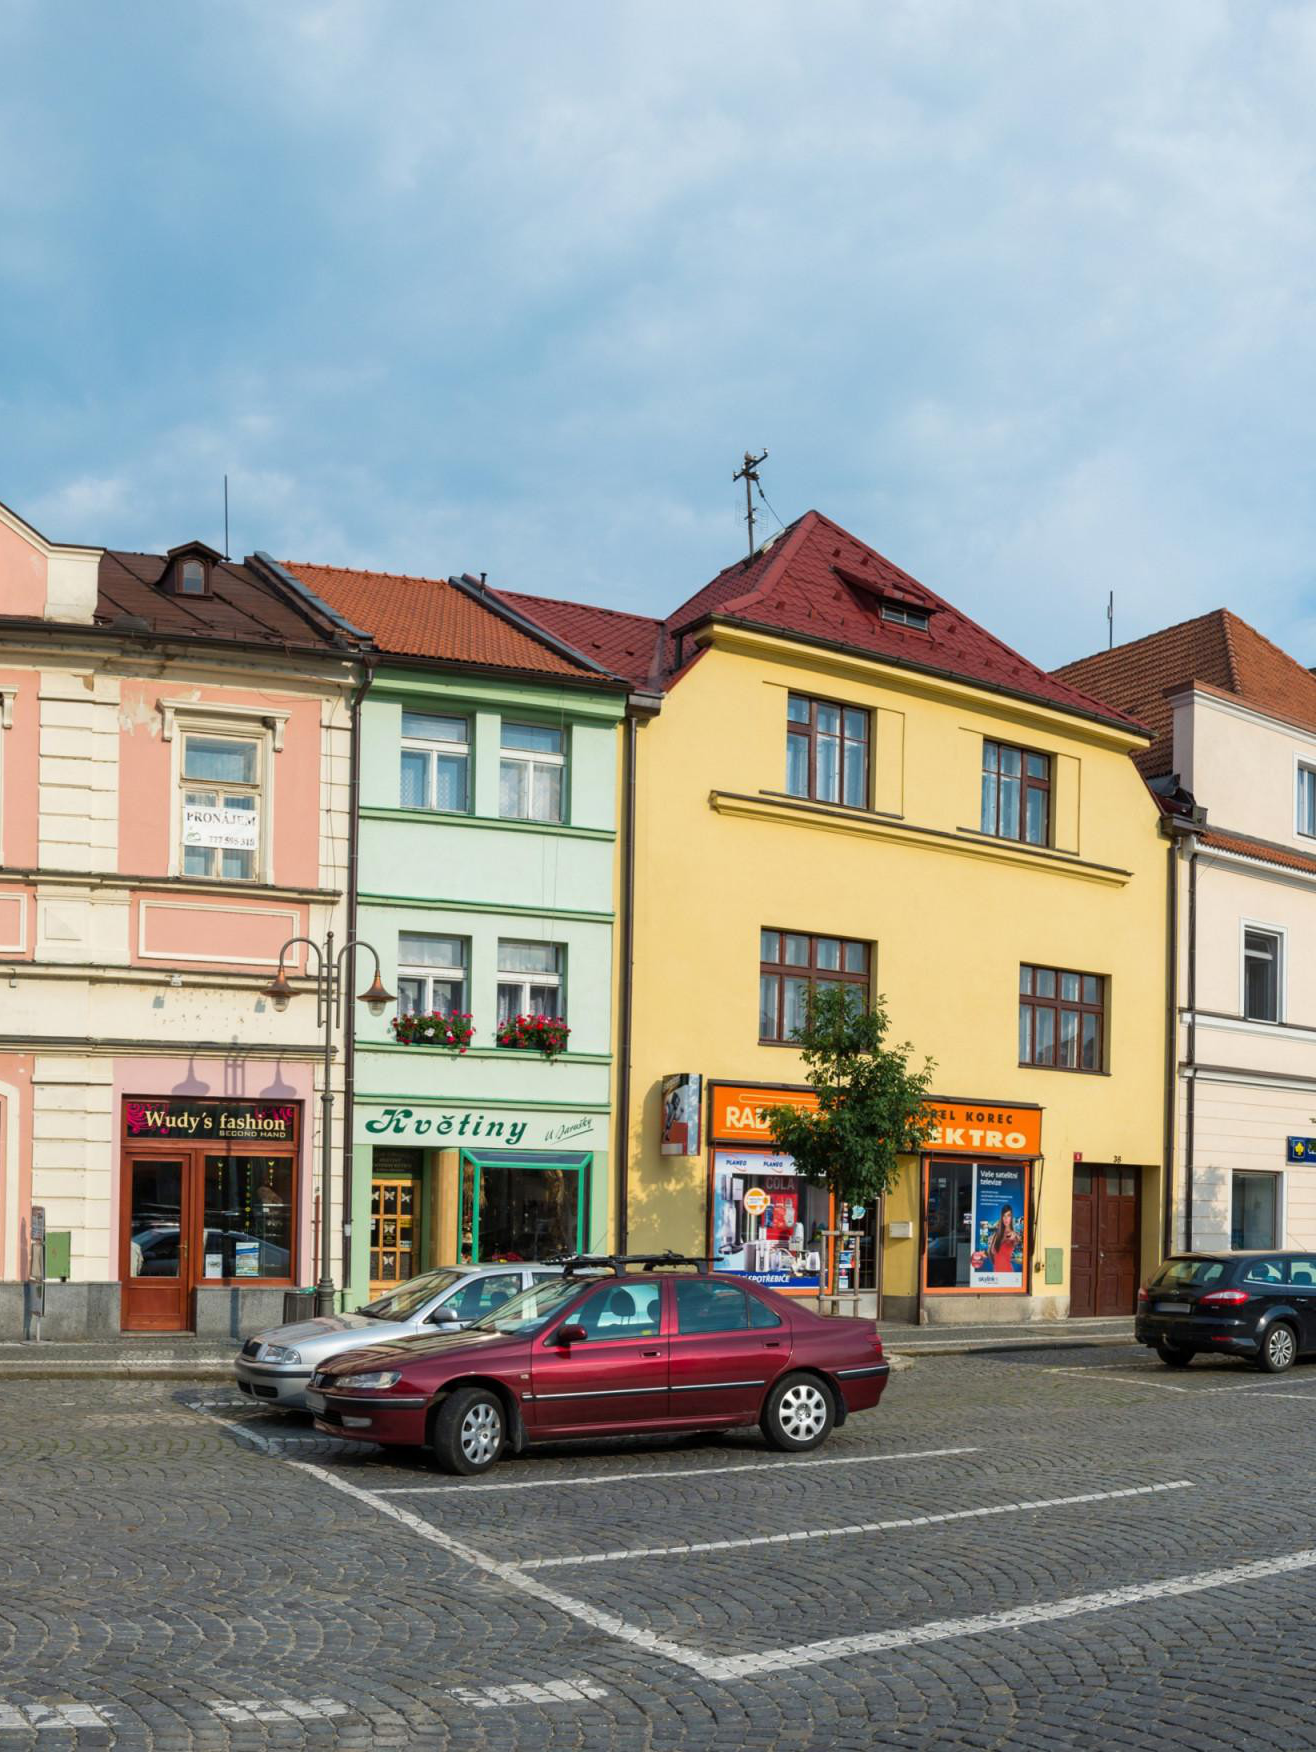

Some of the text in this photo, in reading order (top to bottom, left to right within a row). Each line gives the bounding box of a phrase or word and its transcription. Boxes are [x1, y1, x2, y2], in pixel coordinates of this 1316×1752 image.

[187, 811, 256, 826] PRONÁJEM
[219, 1113, 286, 1131] fashion
[726, 1106, 772, 1129] RAD
[965, 1111, 1013, 1125] KOREC
[365, 1109, 528, 1145] Květiny
[927, 1127, 1027, 1149] EKTRO
[980, 1170, 995, 1178] Vaše
[765, 1176, 795, 1190] COLA
[980, 1178, 1003, 1186] televize
